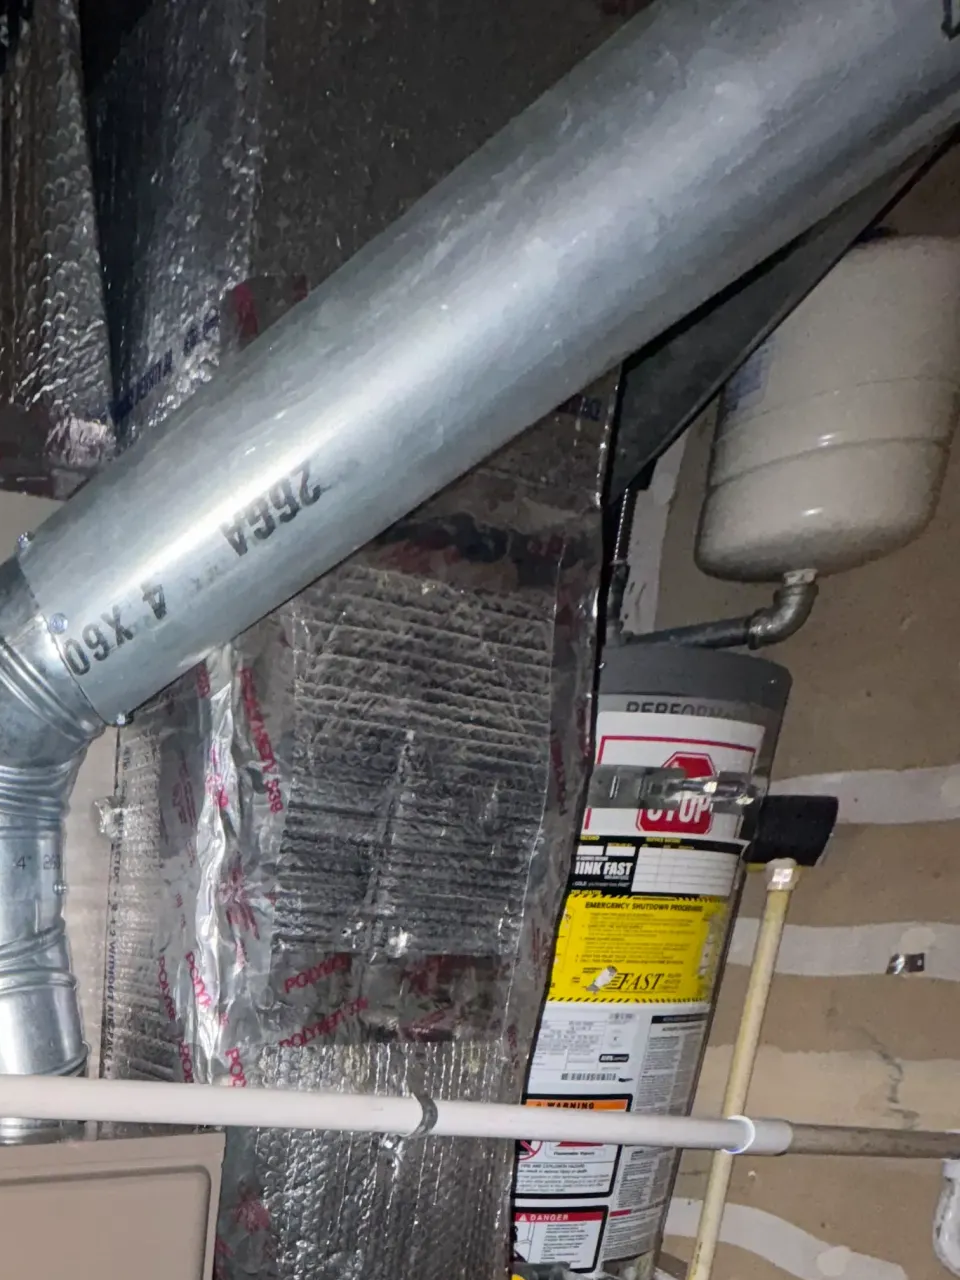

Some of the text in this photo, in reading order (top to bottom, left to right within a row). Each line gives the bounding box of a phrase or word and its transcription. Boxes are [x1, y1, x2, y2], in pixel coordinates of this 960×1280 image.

[140, 580, 168, 620] 4
[63, 605, 134, 676] X60
[603, 862, 633, 875] FAST
[585, 901, 630, 910] EMERGENCY
[632, 903, 669, 911] SHUTDOWN
[617, 972, 664, 990] FAST
[547, 1101, 595, 1110] WARNING
